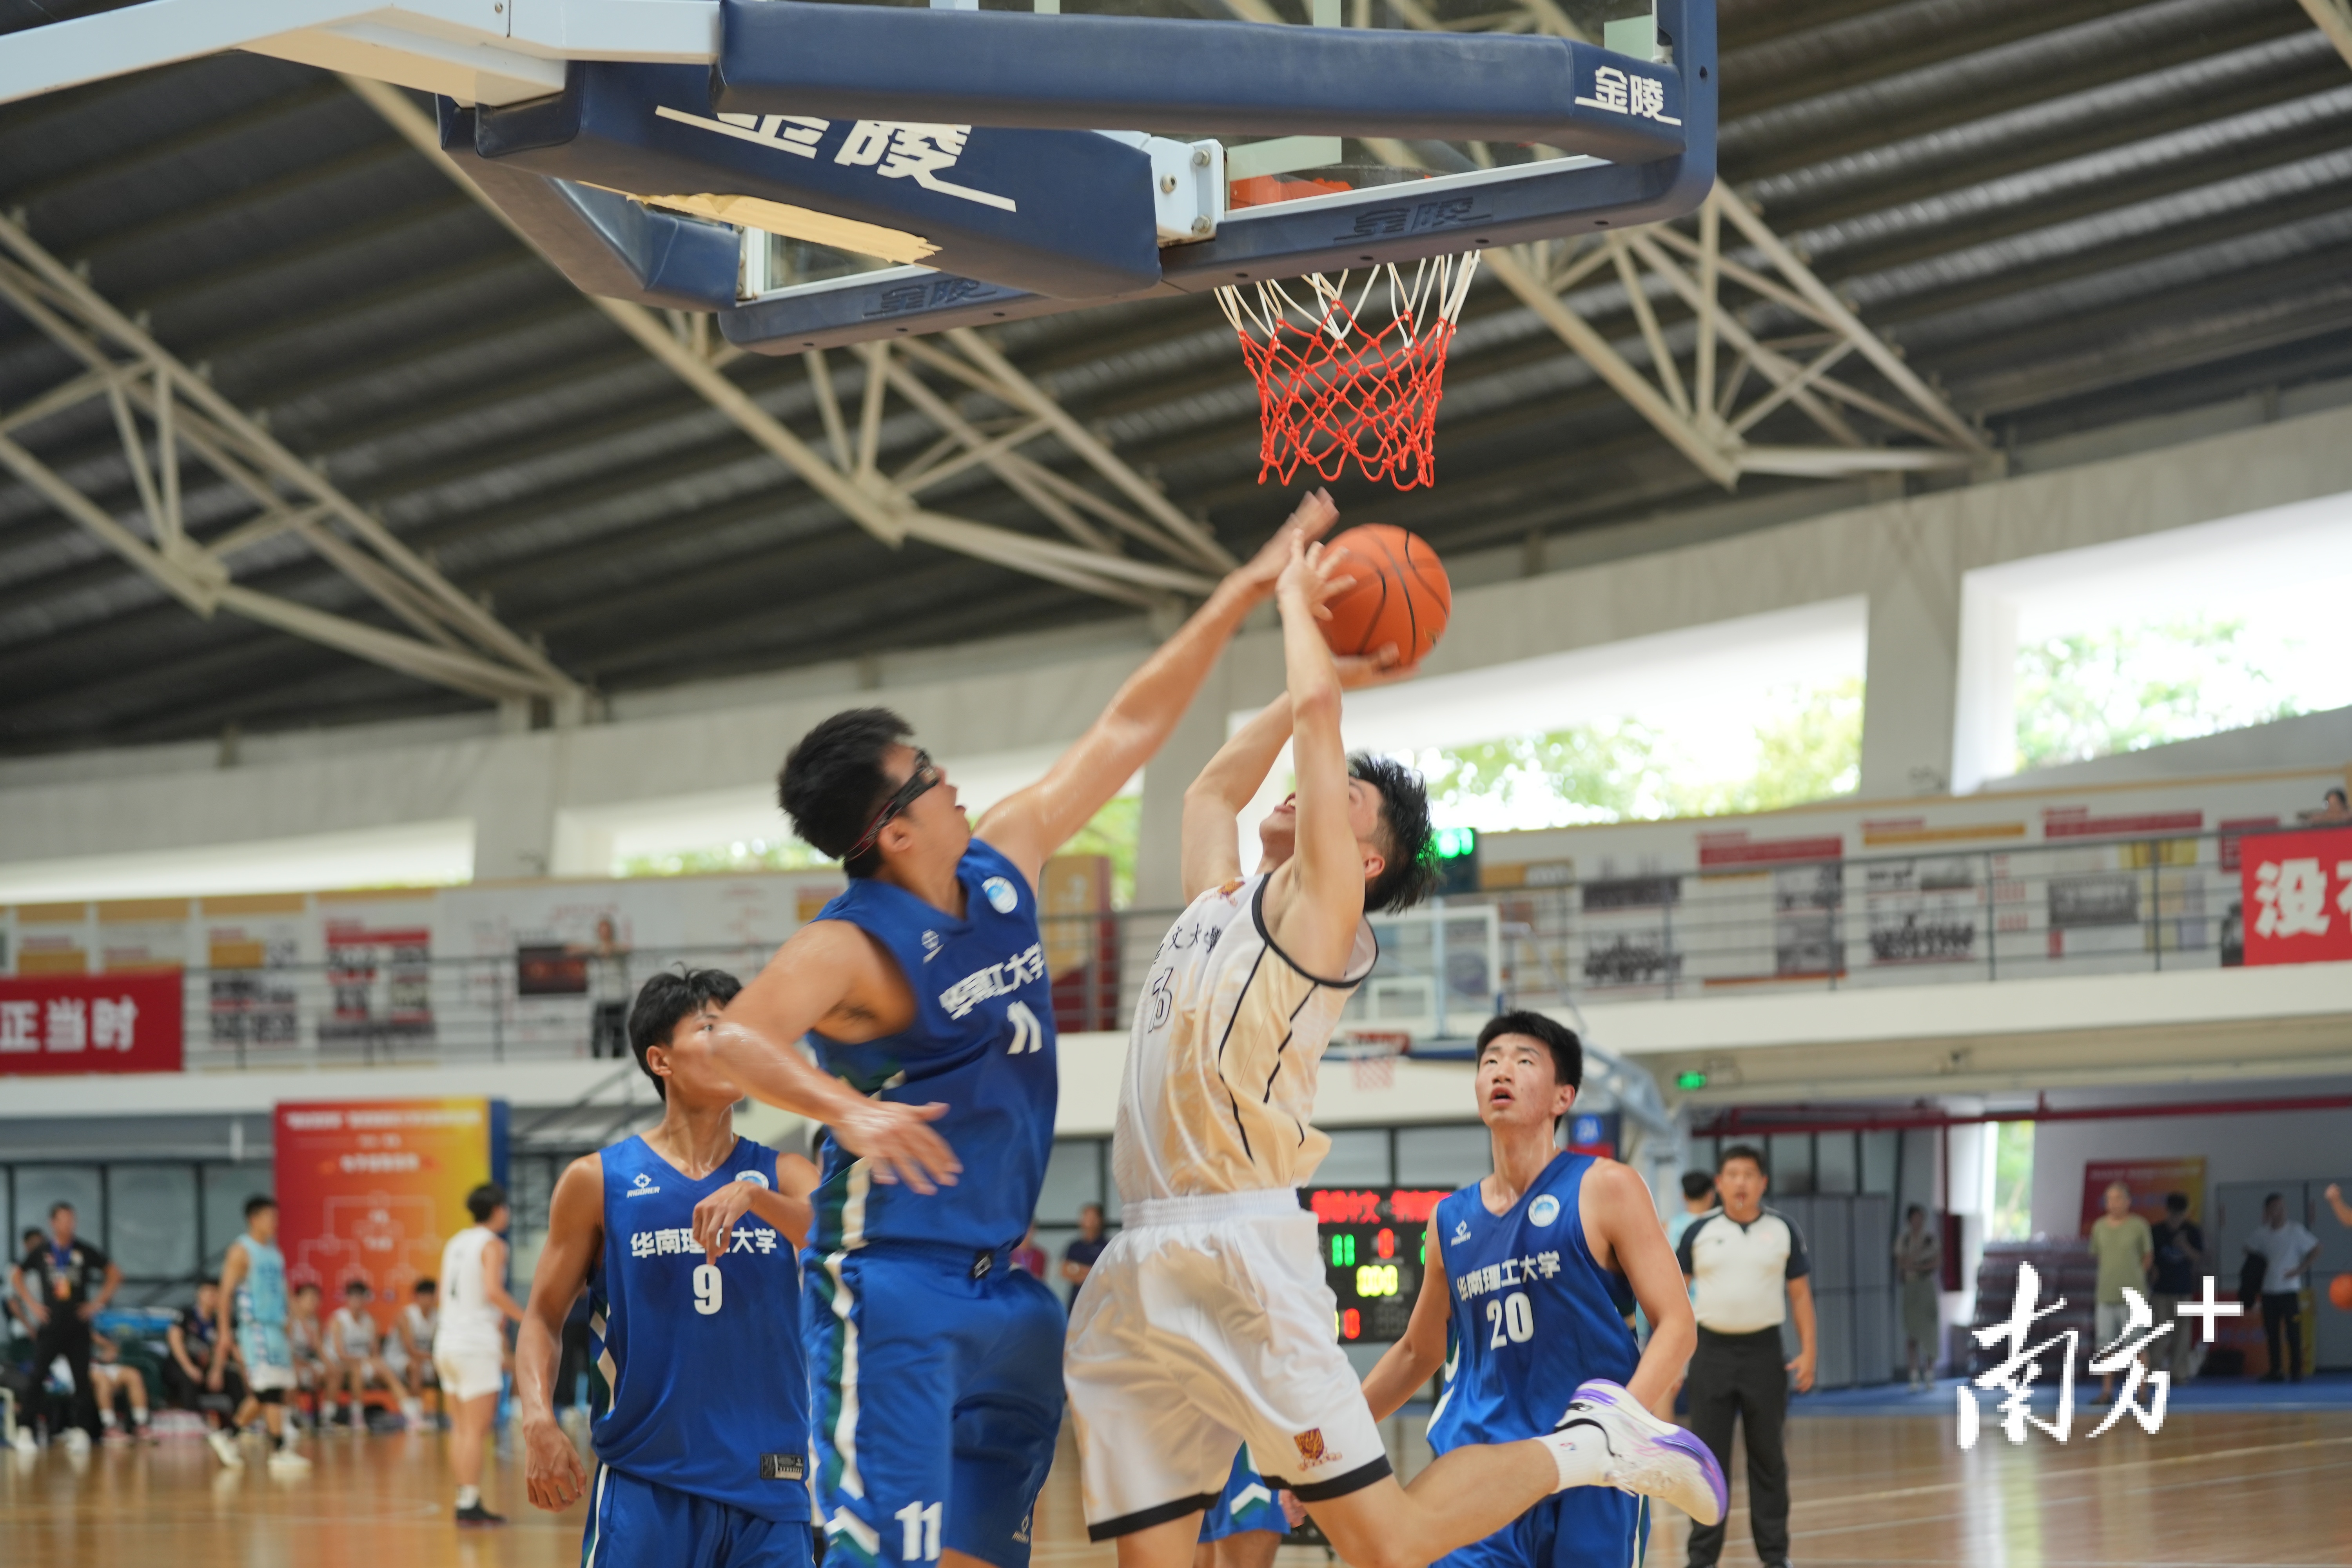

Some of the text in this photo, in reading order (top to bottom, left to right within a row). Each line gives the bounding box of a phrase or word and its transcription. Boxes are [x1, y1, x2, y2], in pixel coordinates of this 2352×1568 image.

[1575, 65, 1682, 126] 金陵
[2254, 857, 2352, 940] 没
[0, 995, 139, 1054] 正当时
[1006, 1000, 1043, 1055] 11
[692, 1264, 723, 1315] 9
[1456, 1250, 1561, 1302] 华南理工大学
[1486, 1291, 1534, 1351] 20
[894, 1501, 943, 1561] 11
